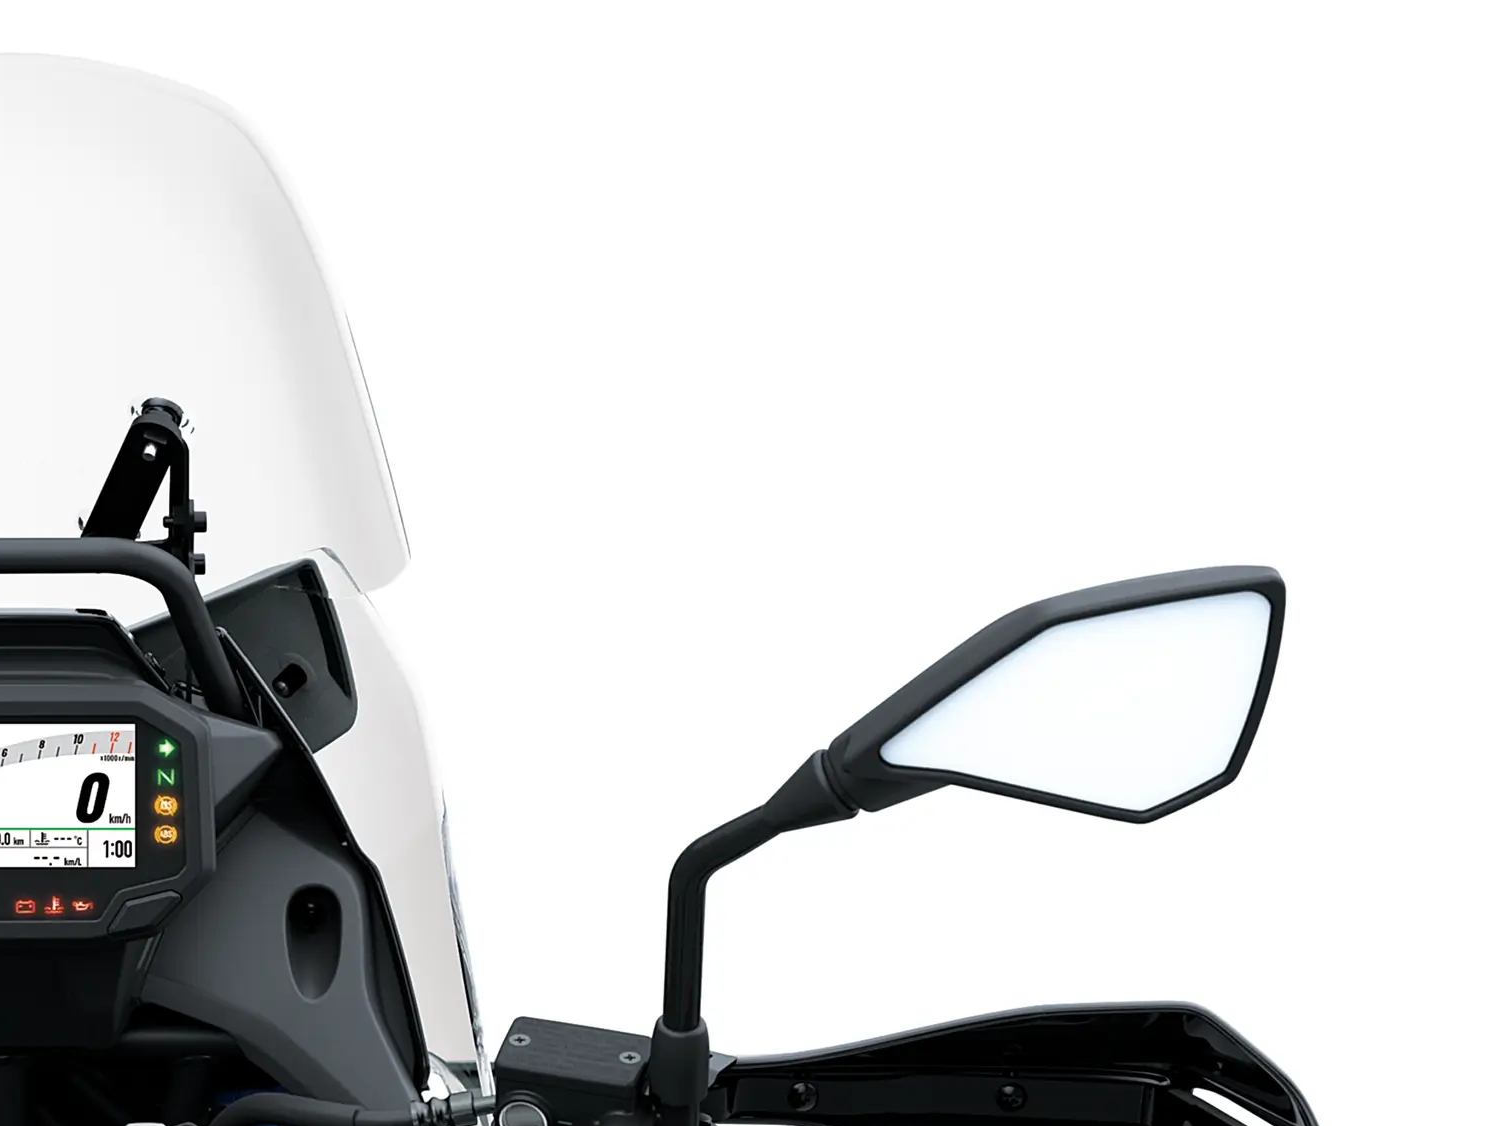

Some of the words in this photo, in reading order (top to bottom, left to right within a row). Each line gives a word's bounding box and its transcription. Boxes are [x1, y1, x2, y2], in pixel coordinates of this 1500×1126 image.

[1, 748, 8, 757] 6
[38, 740, 46, 749] 8
[73, 734, 84, 744] 10
[109, 732, 120, 742] 12
[157, 768, 175, 786] N
[76, 772, 110, 824] 0
[109, 813, 132, 824] km/h
[13, 837, 25, 845] km
[102, 839, 133, 859] 1:00
[63, 857, 82, 866] km/L
